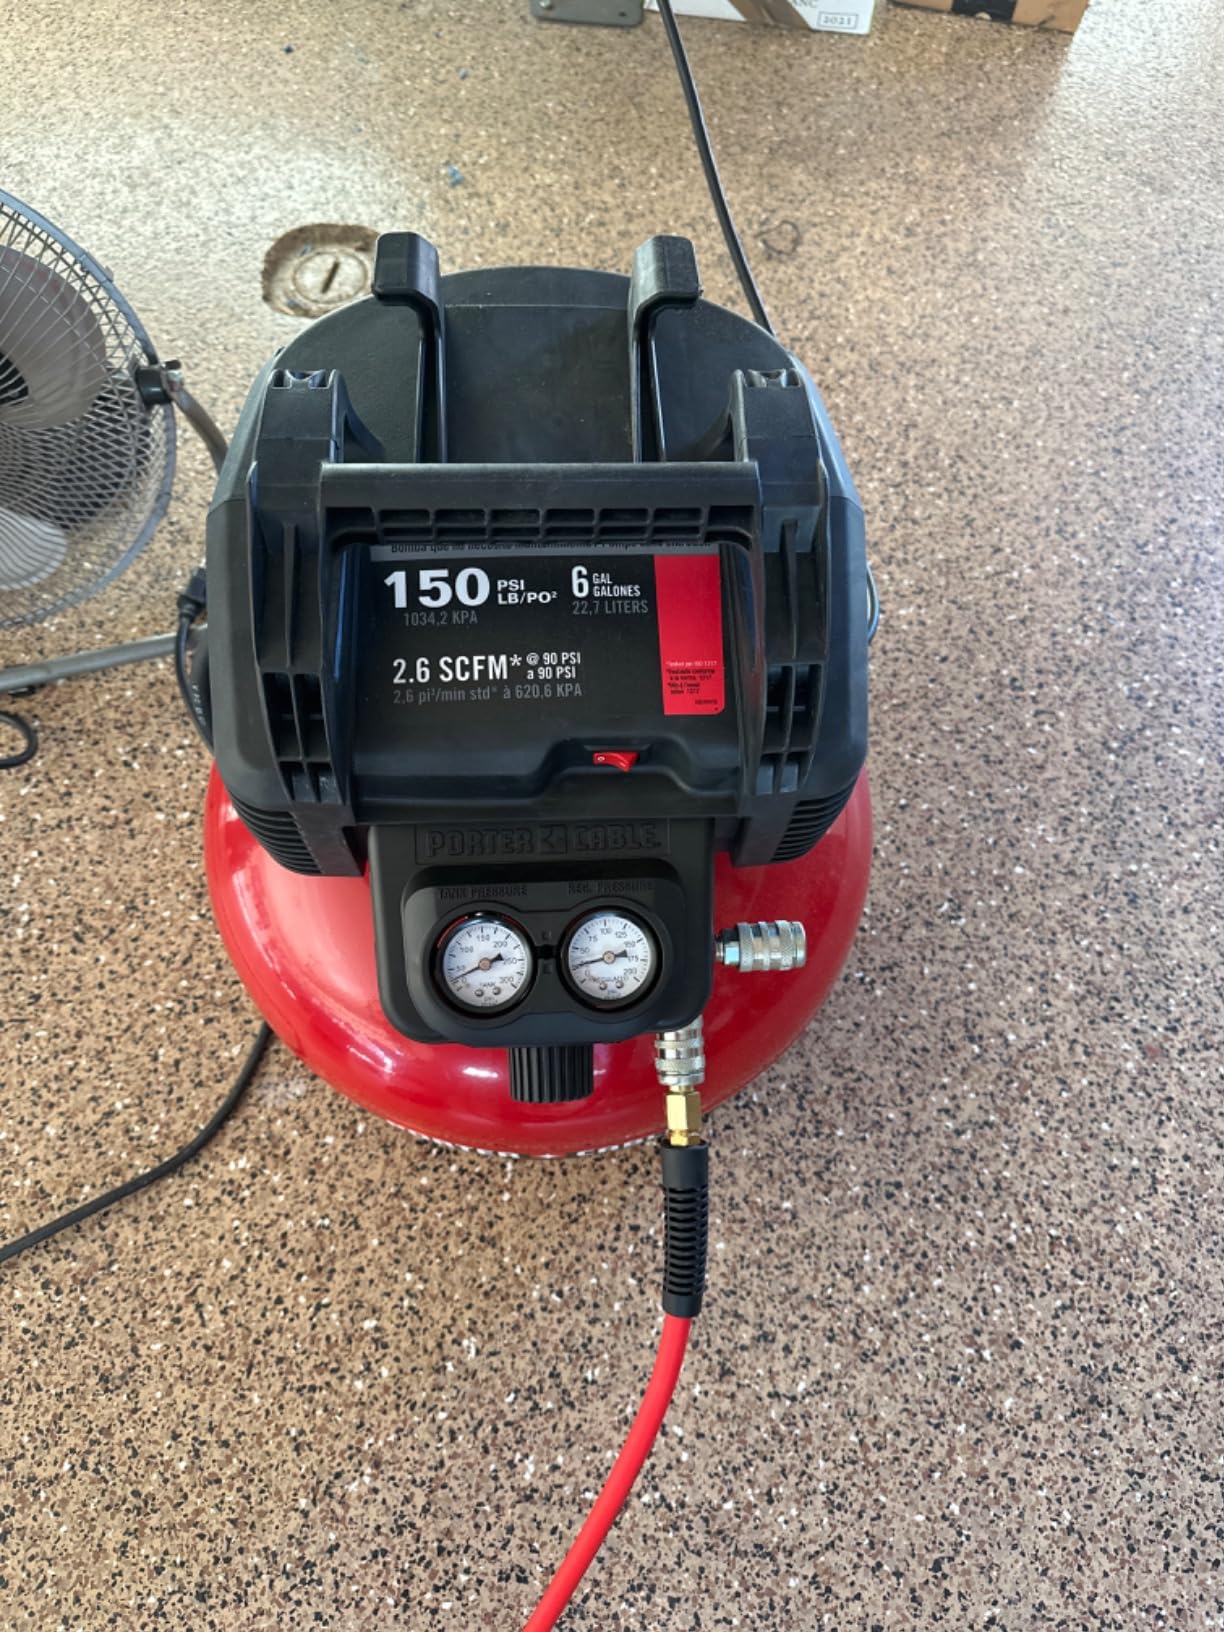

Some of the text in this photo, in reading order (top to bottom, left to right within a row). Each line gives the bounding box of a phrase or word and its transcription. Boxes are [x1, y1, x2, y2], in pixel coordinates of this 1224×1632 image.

[496, 579, 525, 591] PSI
[571, 564, 590, 598] 6
[592, 572, 613, 585] GAL
[383, 566, 491, 609] 150
[592, 584, 641, 598] GALONES
[571, 600, 649, 616] 22,7 LITERS
[403, 610, 479, 627] 1034,2 KPA
[526, 651, 582, 666] @ 90 PSI
[392, 656, 431, 684] 2.6
[537, 666, 553, 680] 90
[556, 665, 577, 679] PSI
[392, 688, 414, 705] 2,6
[503, 685, 512, 700] à
[514, 683, 552, 700] 620,6
[556, 682, 583, 698] KPA
[428, 827, 536, 857] PORTER
[600, 927, 613, 935] 100
[615, 931, 628, 939] 125
[476, 934, 491, 942] 150
[493, 940, 508, 949] 200
[623, 940, 636, 948] 150
[460, 945, 474, 953] 100
[623, 967, 638, 976] 200
[500, 976, 515, 984] 300
